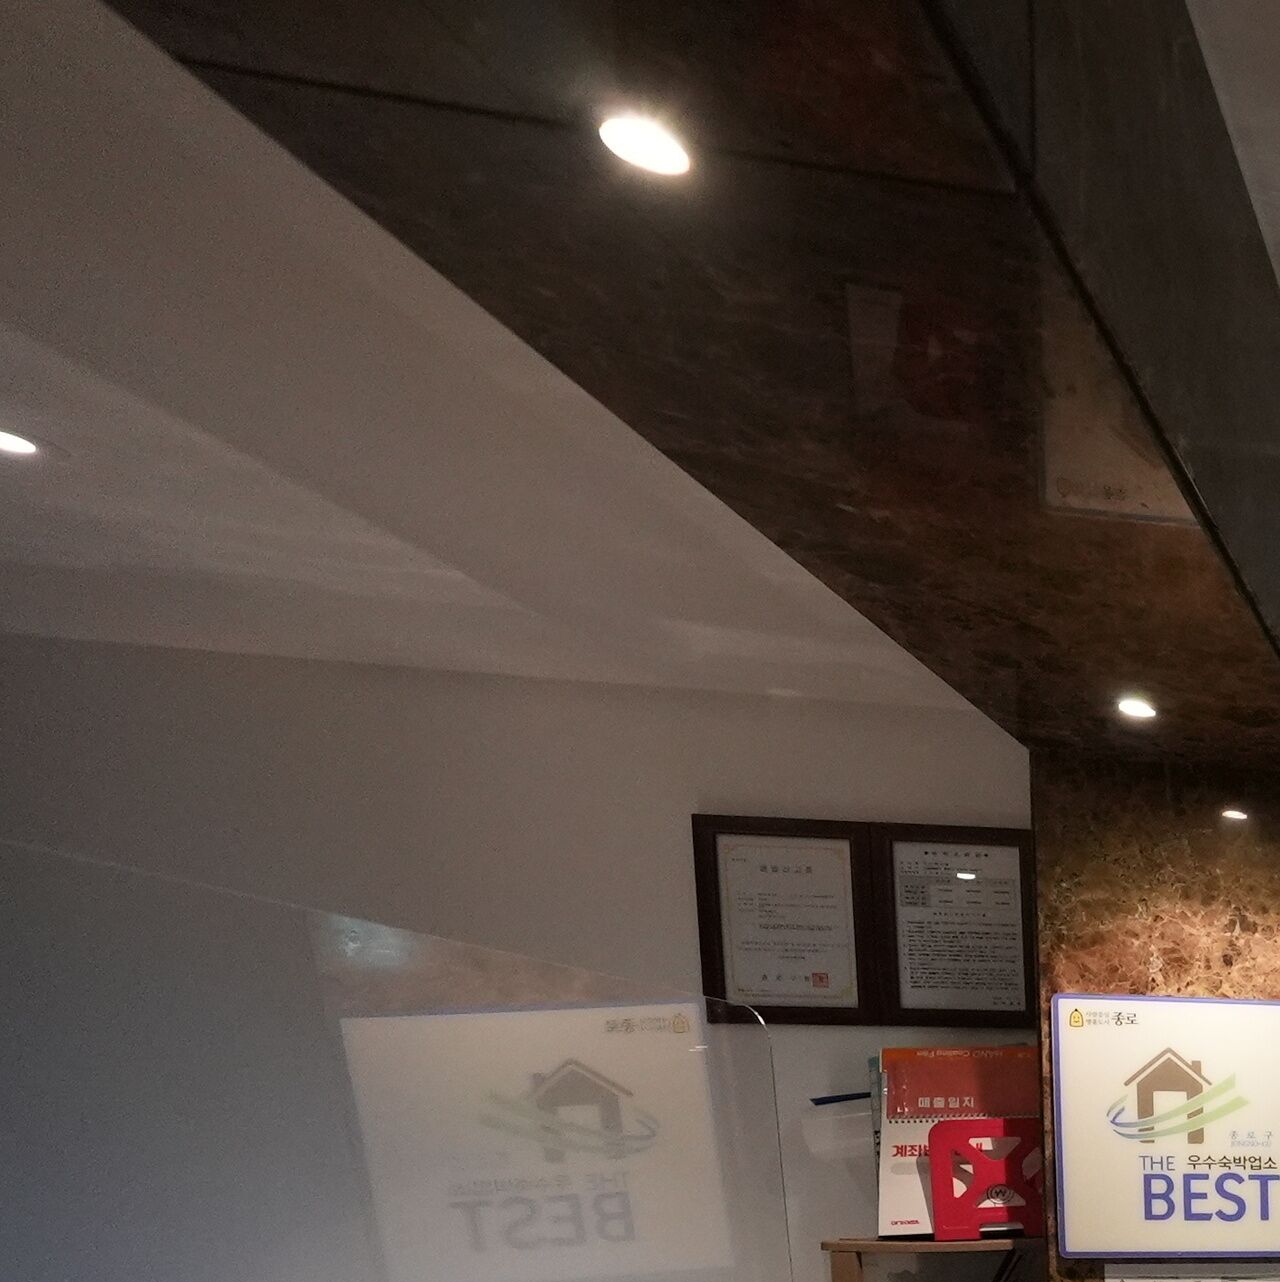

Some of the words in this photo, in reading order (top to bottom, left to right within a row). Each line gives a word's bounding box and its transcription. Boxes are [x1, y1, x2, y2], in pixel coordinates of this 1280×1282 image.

[918, 1096, 974, 1108] 매출일지
[891, 1144, 930, 1157] 계좌
[1139, 1155, 1176, 1171] THE
[1187, 1155, 1278, 1170] 우수숙박업소
[1143, 1172, 1280, 1222] BEST
